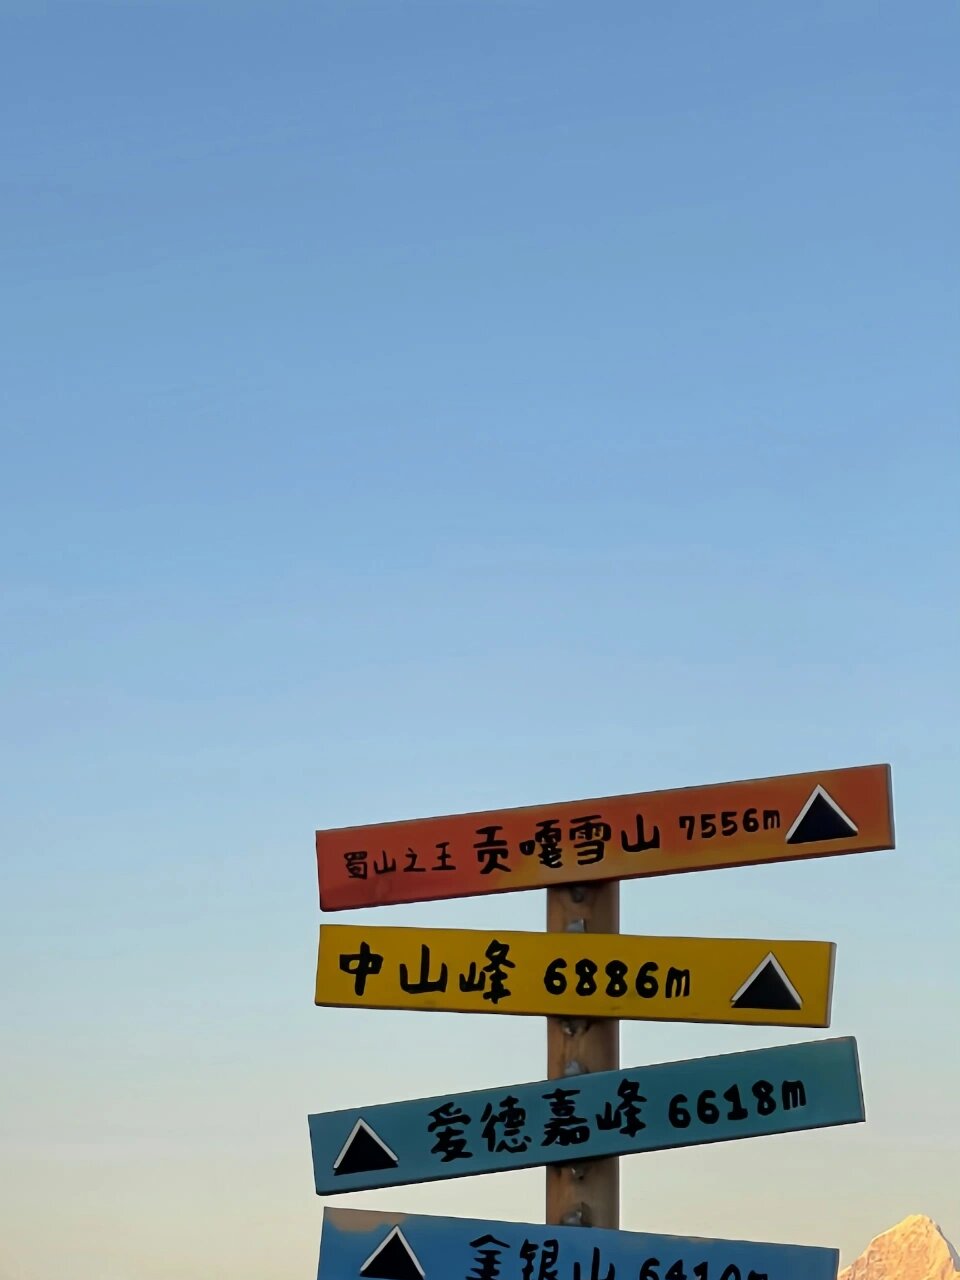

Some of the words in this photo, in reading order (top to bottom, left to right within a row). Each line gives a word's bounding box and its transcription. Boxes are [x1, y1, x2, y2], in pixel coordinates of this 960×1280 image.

[343, 842, 456, 880] 蜀山之王
[473, 813, 661, 875] 贡嘎雪山
[678, 808, 781, 841] 7556m
[339, 939, 516, 1004] 中山峰
[543, 958, 690, 999] 6886m
[427, 1079, 648, 1163] 爱德嘉峰
[668, 1079, 807, 1130] 6618m
